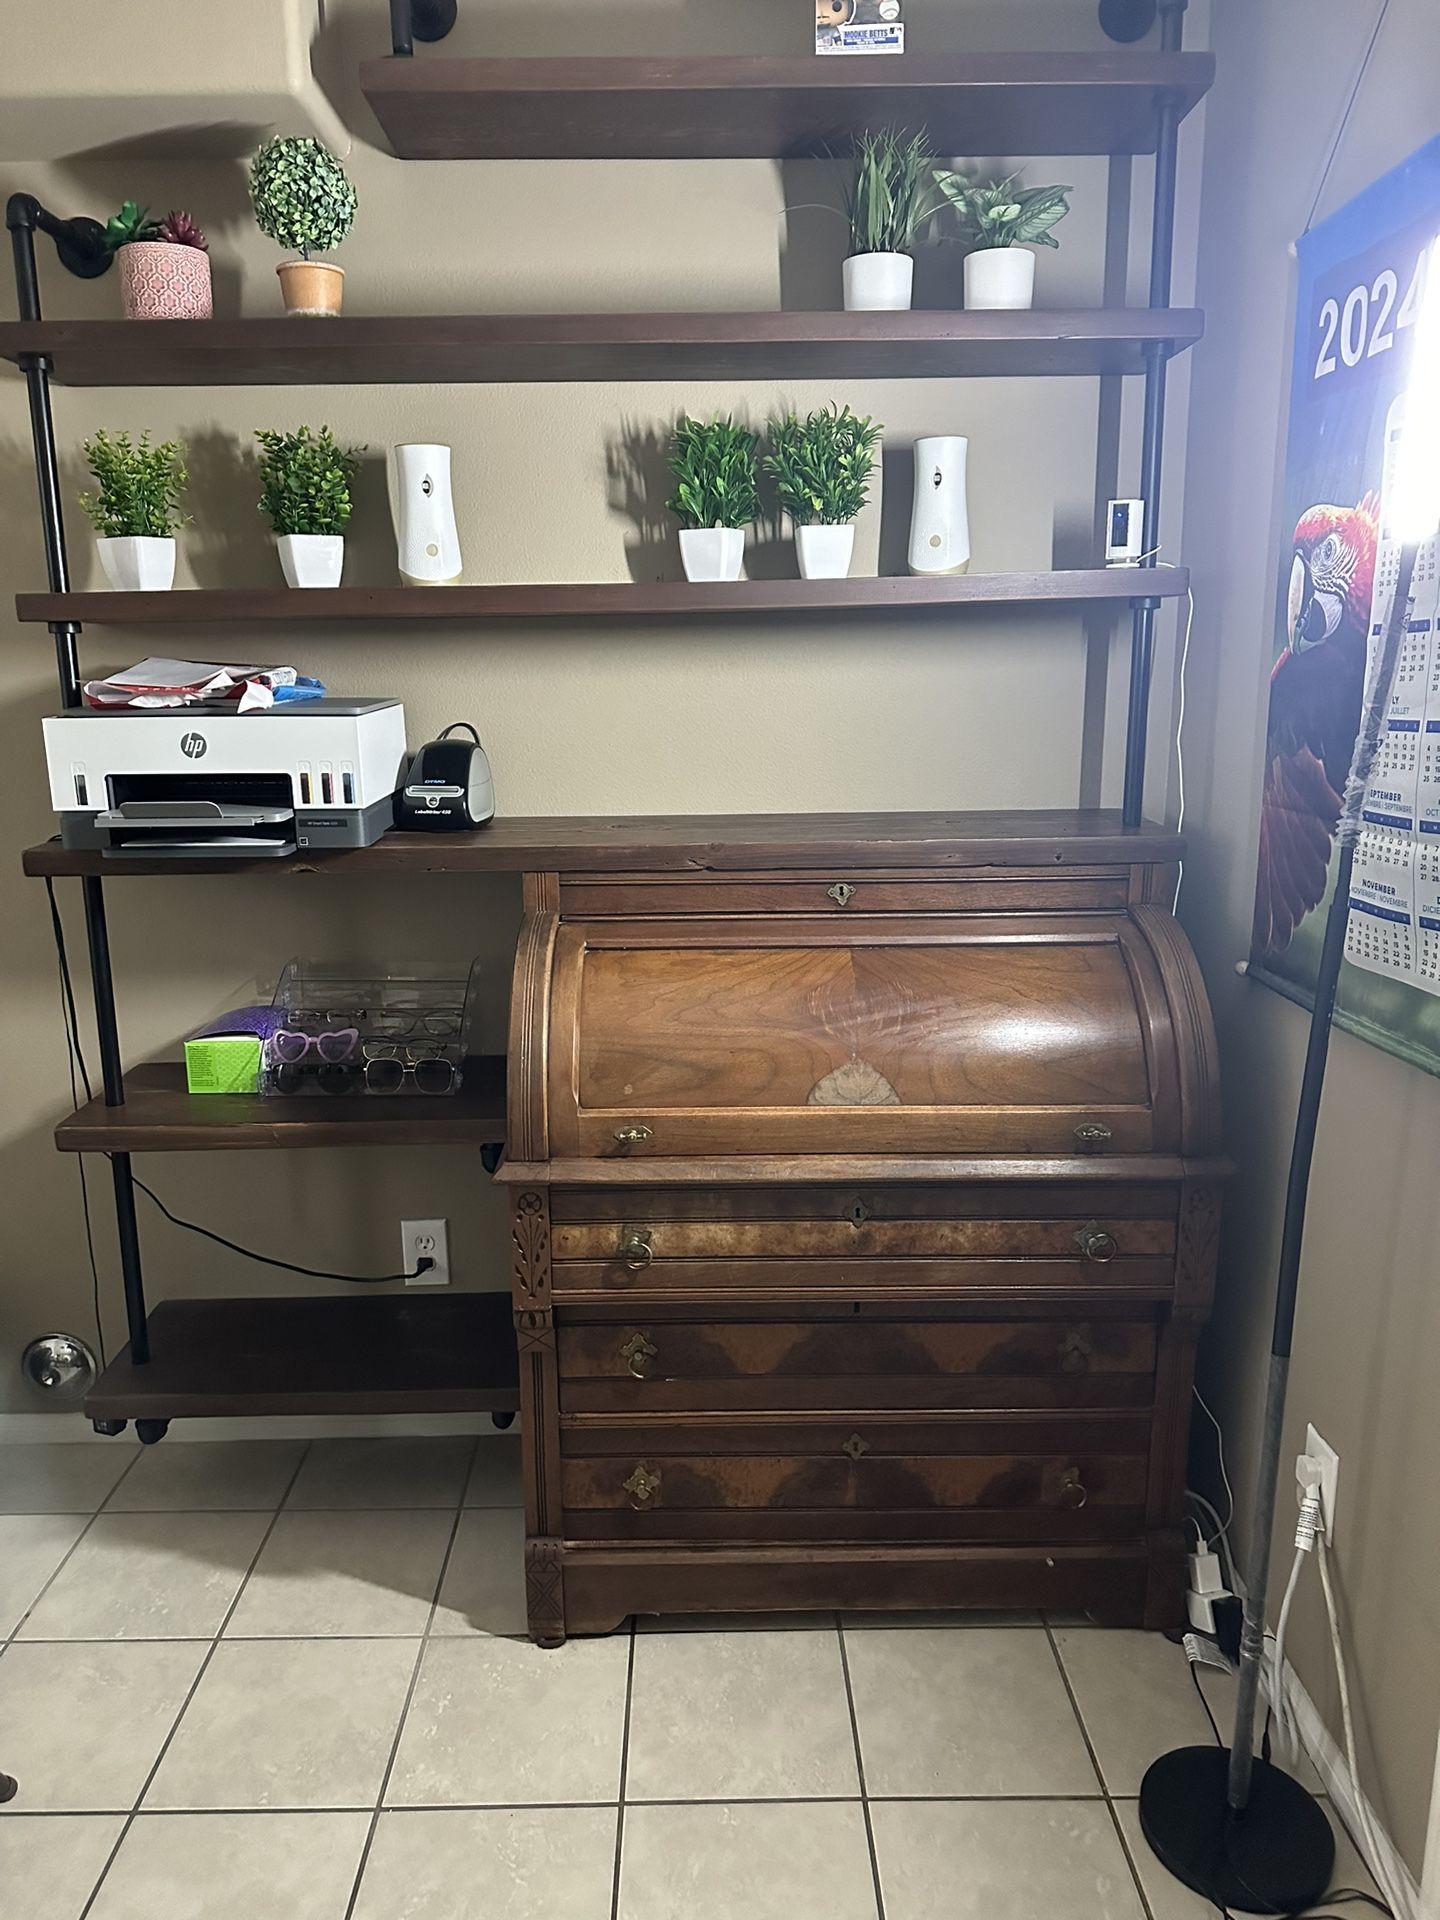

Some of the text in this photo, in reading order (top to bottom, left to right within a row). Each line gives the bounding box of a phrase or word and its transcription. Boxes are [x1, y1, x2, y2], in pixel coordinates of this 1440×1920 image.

[869, 29, 888, 38] BETTS
[1314, 247, 1428, 379] 2024
[184, 732, 203, 758] hp
[1371, 789, 1401, 801] EPTEMBER
[1362, 879, 1396, 895] NOVEMBER
